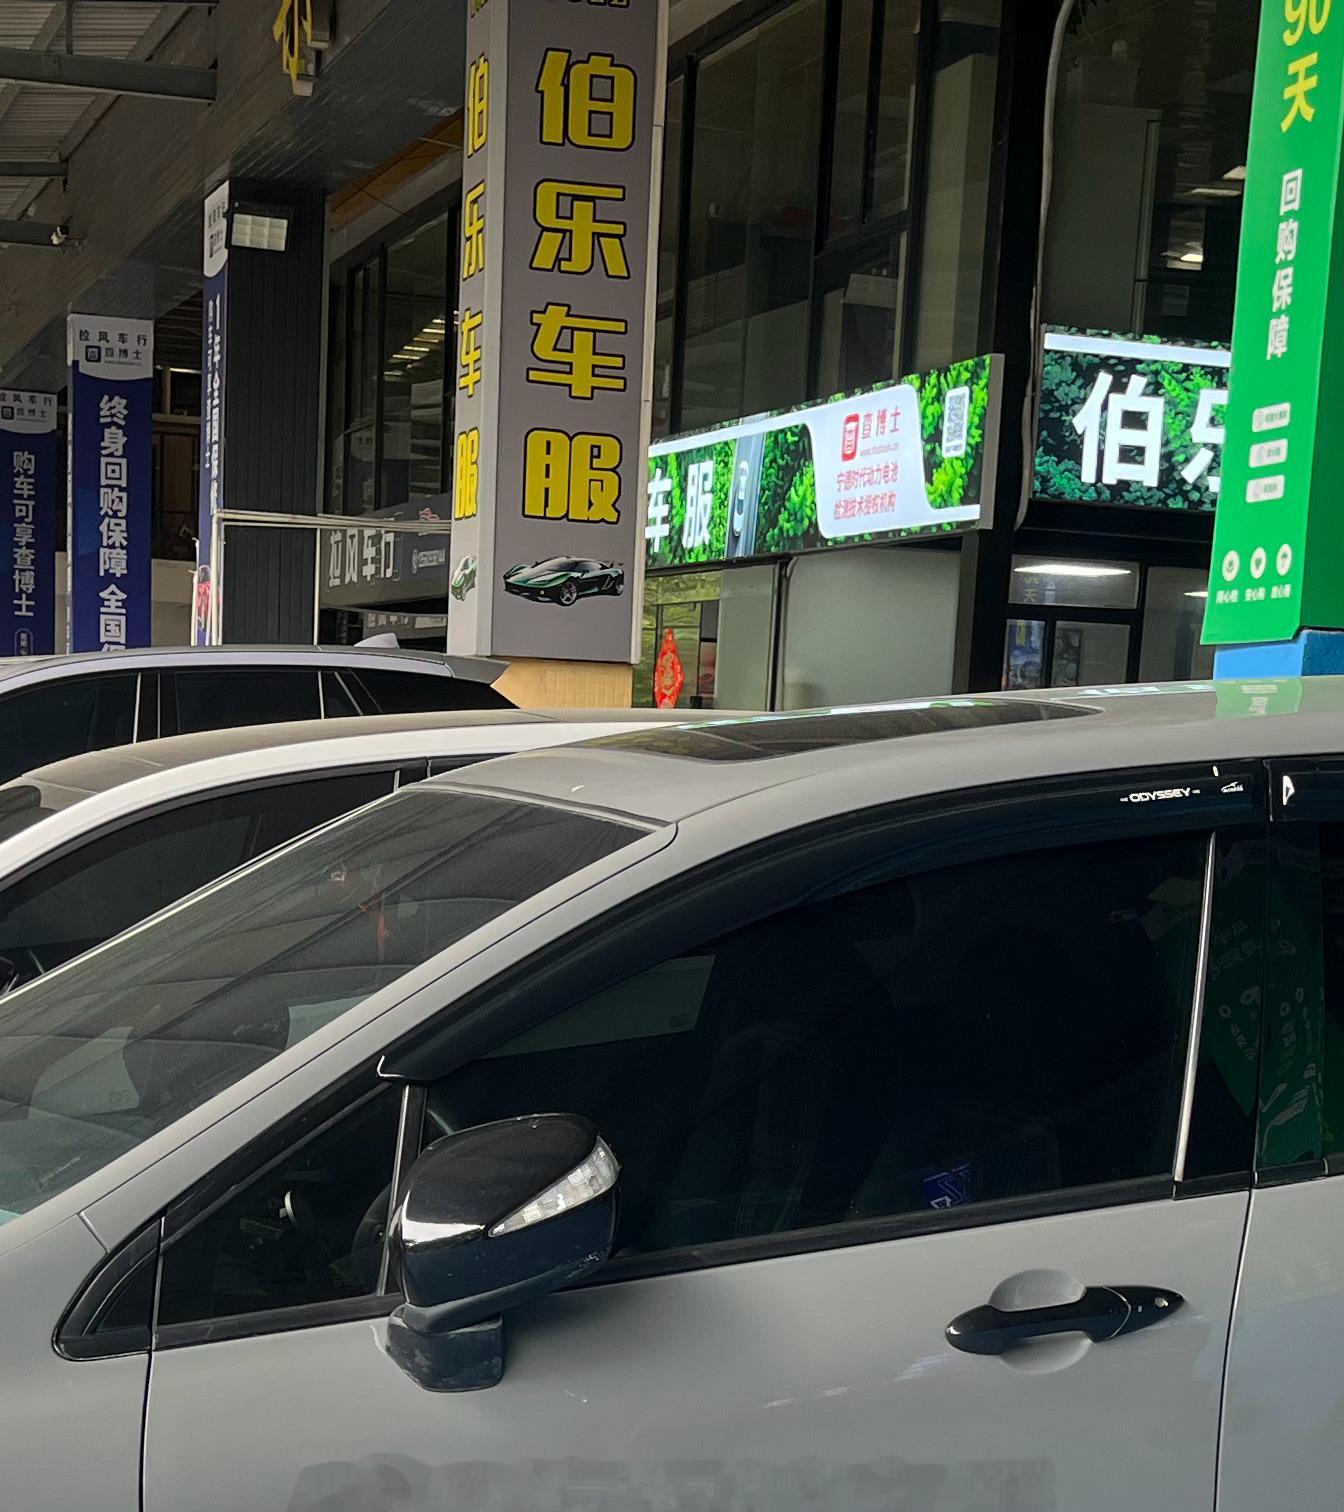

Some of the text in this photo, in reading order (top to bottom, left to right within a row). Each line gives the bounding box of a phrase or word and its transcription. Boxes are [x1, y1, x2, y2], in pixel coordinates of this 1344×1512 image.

[455, 0, 490, 520] 伯乐车服
[523, 0, 638, 524] 伯乐车服
[1266, 168, 1303, 360] 回购保障
[99, 395, 129, 578] 终身回购保障
[645, 460, 714, 553] 车服
[861, 405, 902, 439] 查博士
[13, 450, 36, 617] 购车可享查博士
